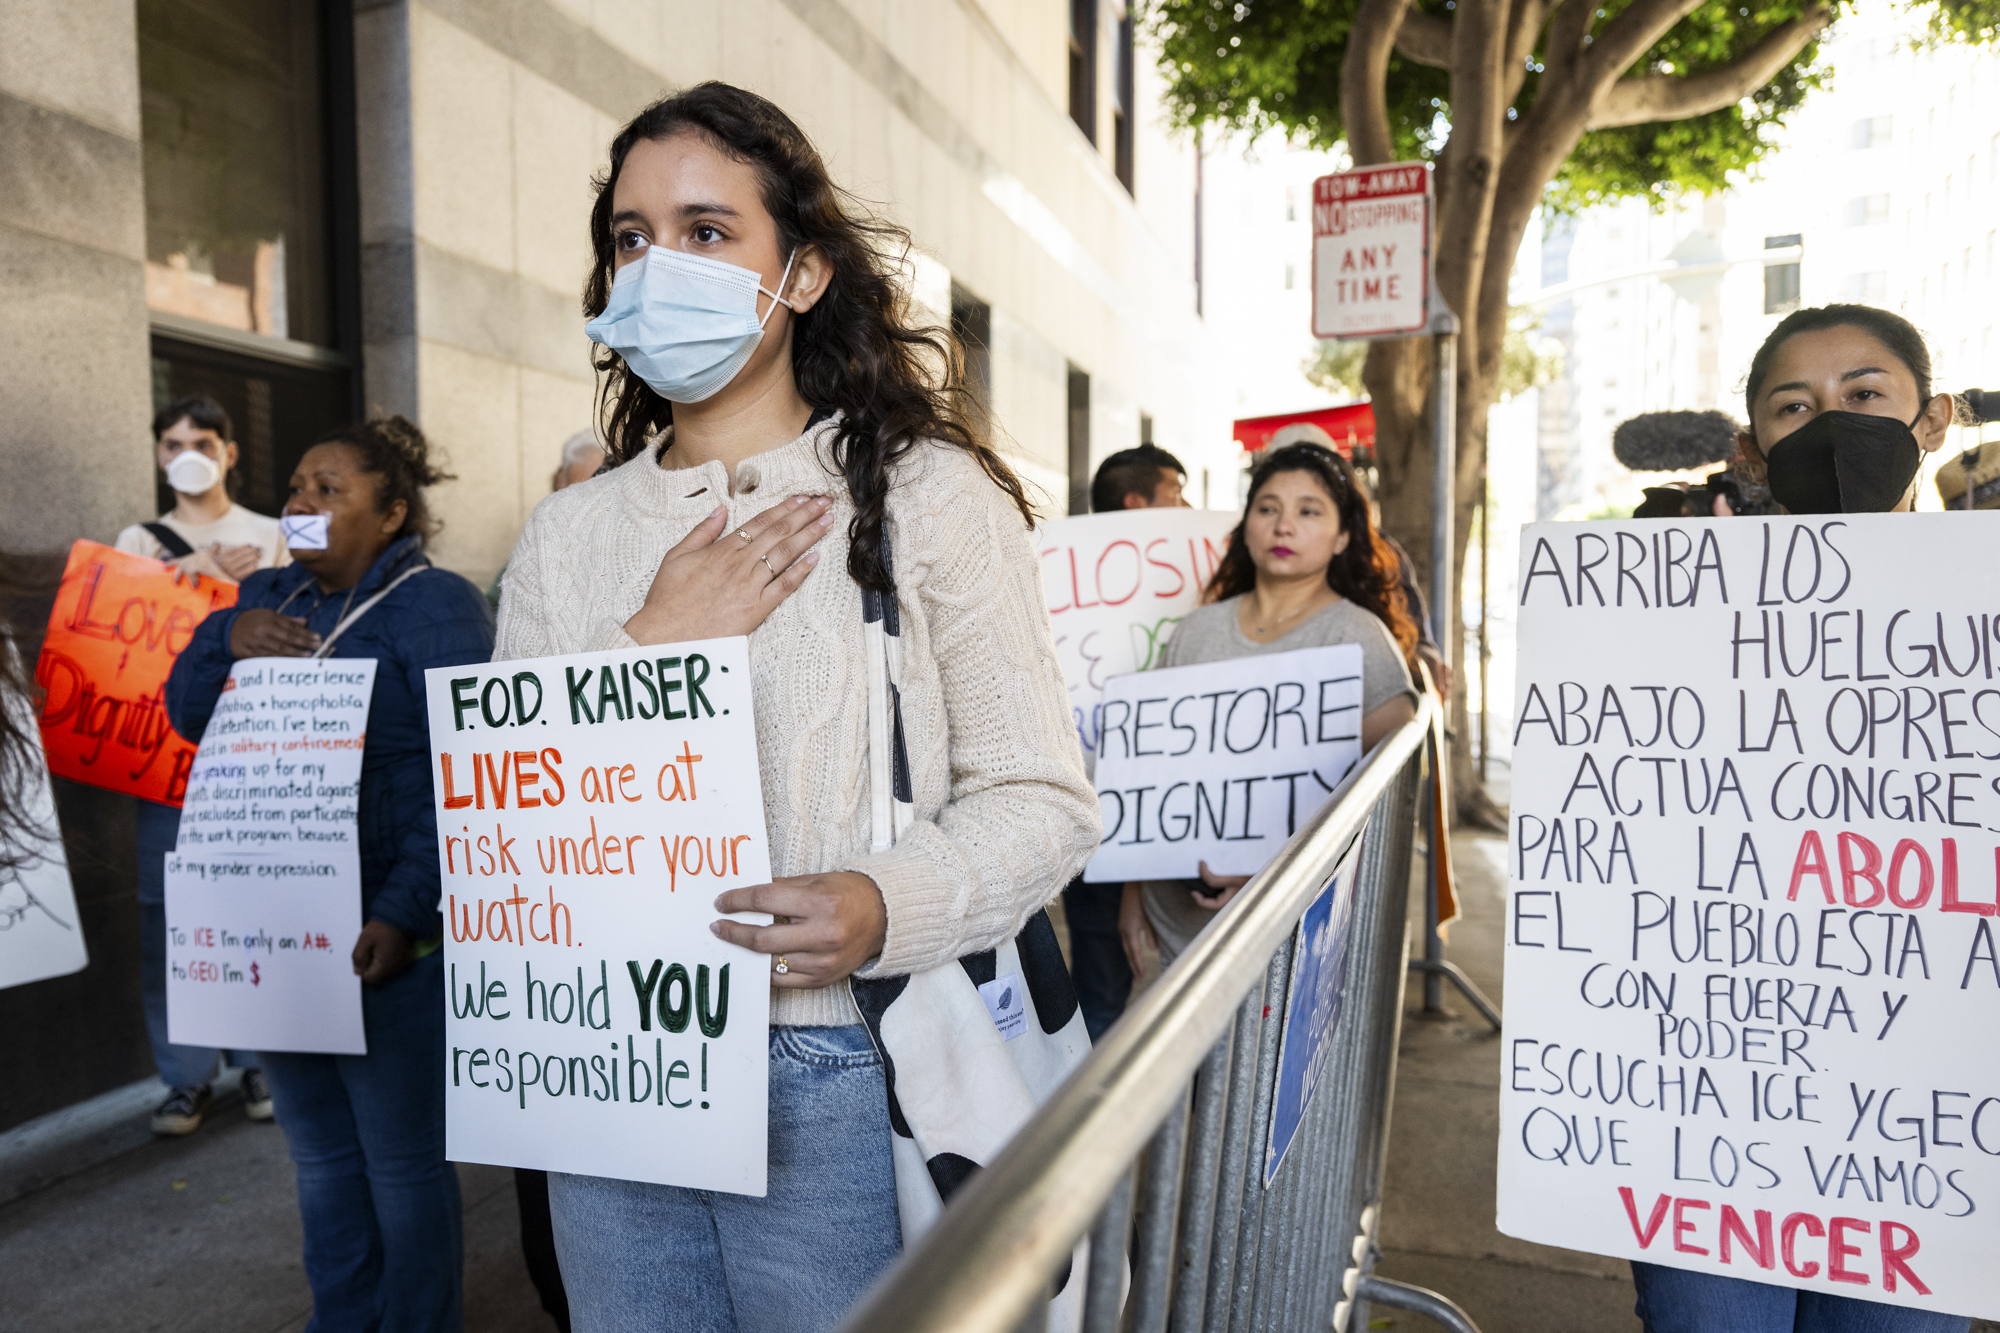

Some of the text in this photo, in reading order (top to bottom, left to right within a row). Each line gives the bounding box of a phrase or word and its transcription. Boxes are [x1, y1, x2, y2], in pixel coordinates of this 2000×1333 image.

[1315, 200, 1420, 235] NO STOPPING
[1319, 168, 1421, 200] TOW-AWAY
[1336, 275, 1402, 305] TIME
[1340, 244, 1397, 273] ANY
[1520, 521, 1852, 609] ARRIBA LOS
[64, 562, 196, 657] Love
[240, 670, 263, 688] and
[277, 670, 365, 687] experience
[270, 694, 363, 712] homophobia
[450, 654, 730, 731] F.O.D. KAISER:
[36, 648, 171, 782] Dignity
[230, 735, 277, 755] solitary
[282, 732, 366, 752] confinement
[283, 715, 307, 732] I've
[313, 716, 350, 732] been
[1100, 676, 1361, 759] RESTORE
[1513, 682, 1705, 749] ABAJO
[1738, 688, 1805, 755] LA
[212, 779, 312, 800] discriminated
[316, 779, 361, 804] against
[253, 763, 270, 778] up
[276, 757, 297, 777] for
[302, 763, 325, 783] my
[441, 740, 703, 810] LIVES are at
[1561, 751, 1753, 822] ACTUA
[189, 827, 203, 845] the
[207, 826, 234, 843] work
[237, 829, 293, 846] program
[297, 827, 349, 843] because
[199, 804, 246, 822] excluded
[251, 803, 285, 821] from
[168, 857, 182, 874] of
[187, 861, 205, 879] my
[210, 861, 251, 882] gender
[446, 815, 751, 893] risk under your
[1517, 814, 1639, 885] PARA
[1697, 825, 1769, 901] LA
[168, 927, 187, 947] To
[194, 928, 215, 948] ICE
[221, 929, 241, 947] I'm
[243, 928, 273, 955] only
[278, 937, 298, 950] an
[449, 883, 582, 947] watch.
[1514, 890, 1592, 953] EL
[1631, 890, 1800, 969] PUEBLO
[1815, 908, 1931, 980] ESTA
[172, 960, 260, 988] to GEO I'm $
[451, 958, 730, 1038] We hold YOU
[1580, 962, 1908, 1041] CON FUERZA Y
[453, 1034, 710, 1110] responsible!
[1511, 1038, 1729, 1119] ESCUCHA
[1752, 1070, 1822, 1124] ICE
[1521, 1106, 1977, 1218] QUE LOS VAMOS
[1617, 1186, 1933, 1295] VENCER
